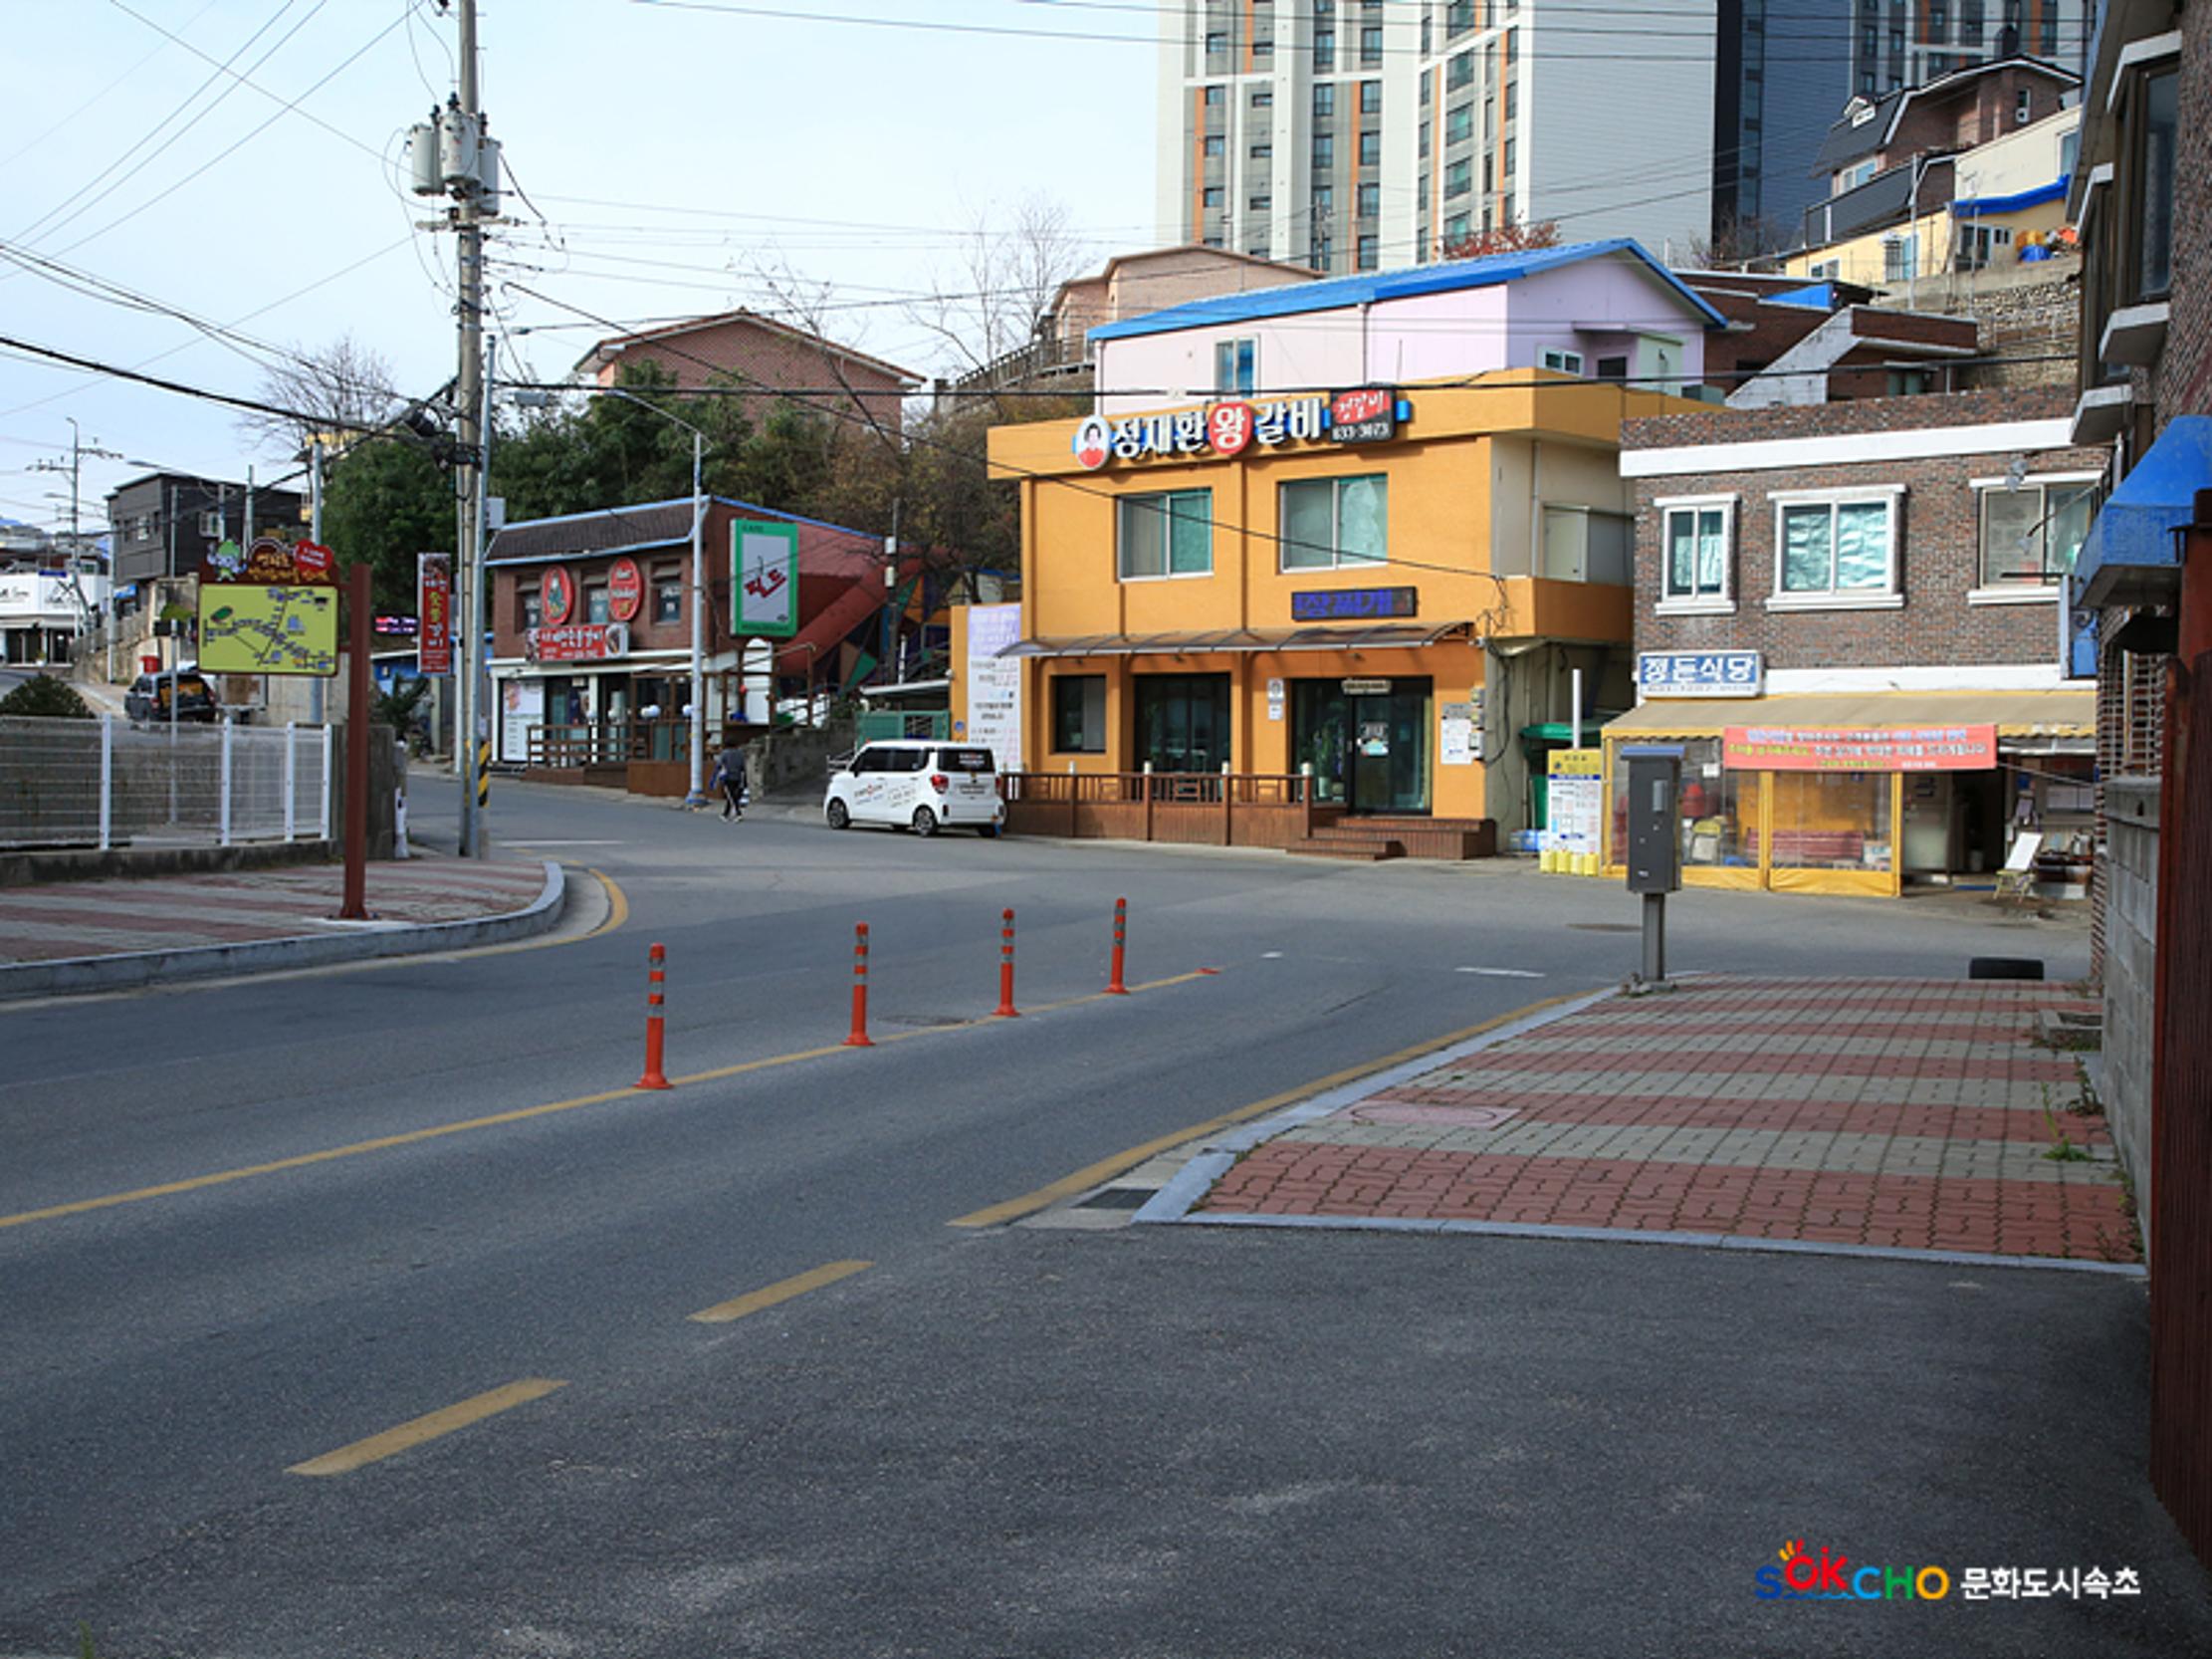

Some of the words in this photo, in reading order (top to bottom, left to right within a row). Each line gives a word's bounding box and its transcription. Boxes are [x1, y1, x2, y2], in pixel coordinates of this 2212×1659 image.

[1111, 411, 1207, 458] 정재한
[1214, 407, 1246, 448] 왕
[1255, 398, 1323, 444] 갈비
[1644, 656, 1754, 682] 정든식당
